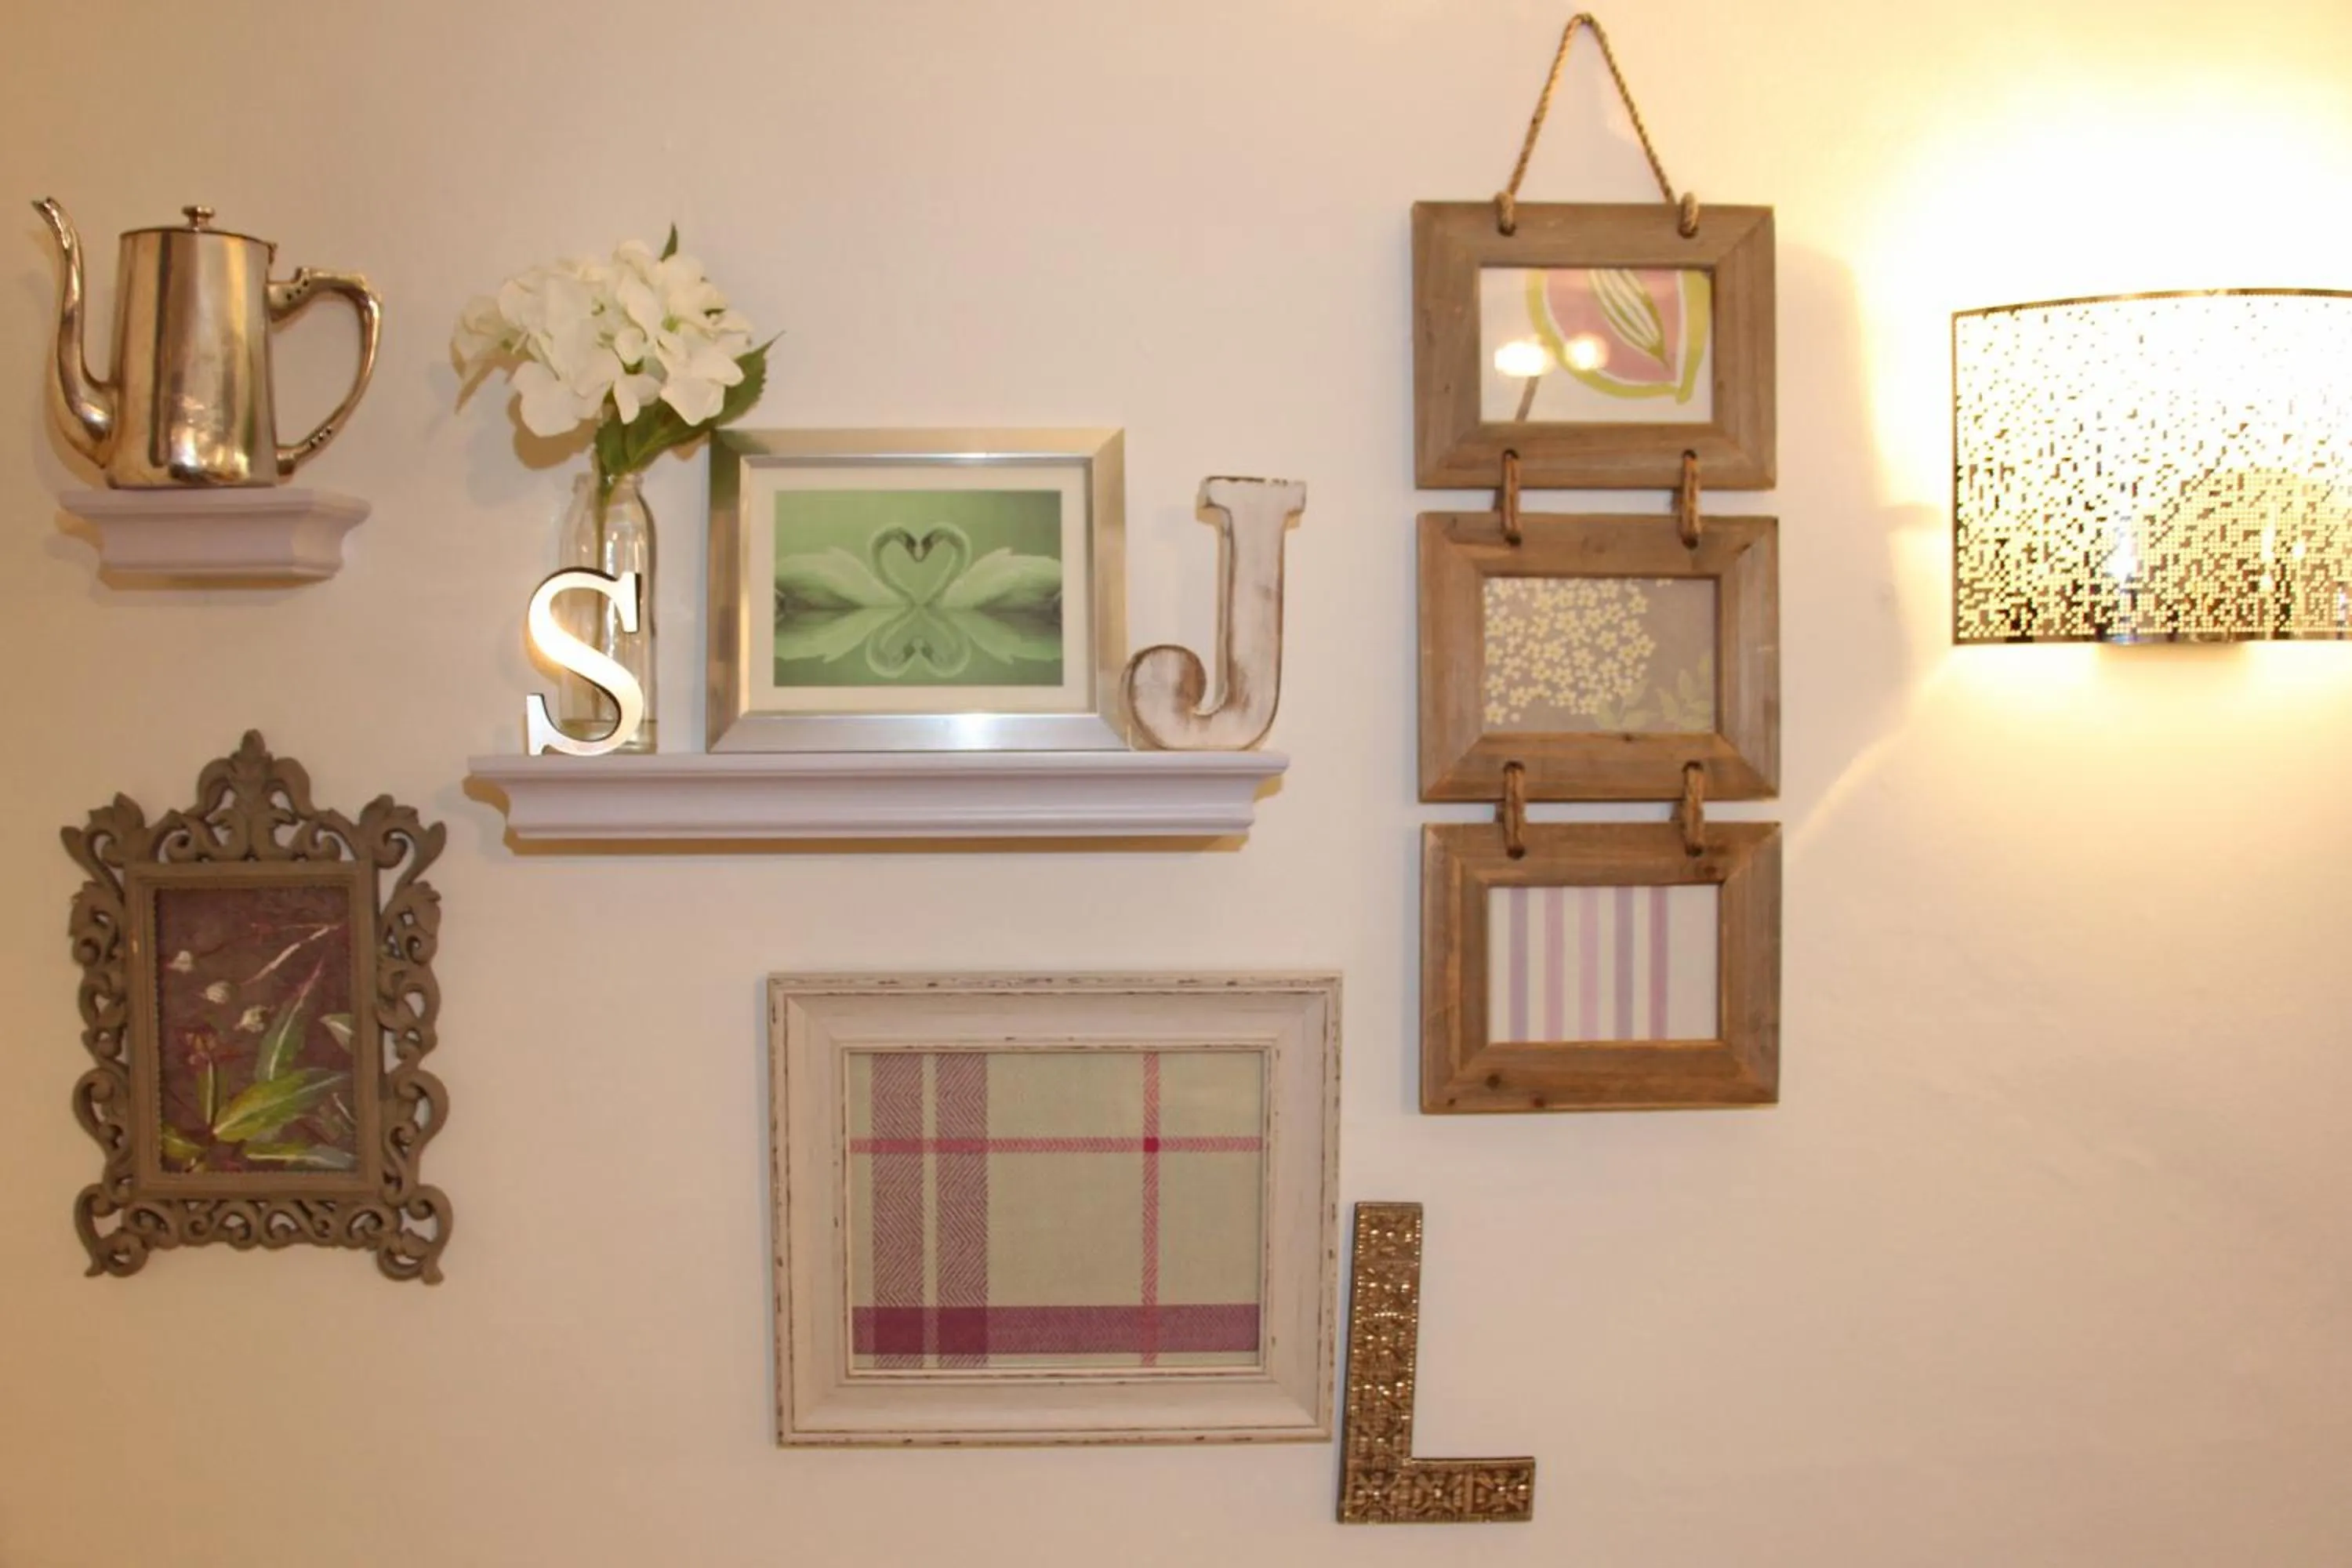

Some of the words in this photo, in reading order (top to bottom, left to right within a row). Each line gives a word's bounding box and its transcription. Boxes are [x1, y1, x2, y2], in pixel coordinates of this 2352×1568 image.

[527, 566, 644, 756] S
[1120, 476, 1307, 751] J
[1338, 1202, 1535, 1523] L
